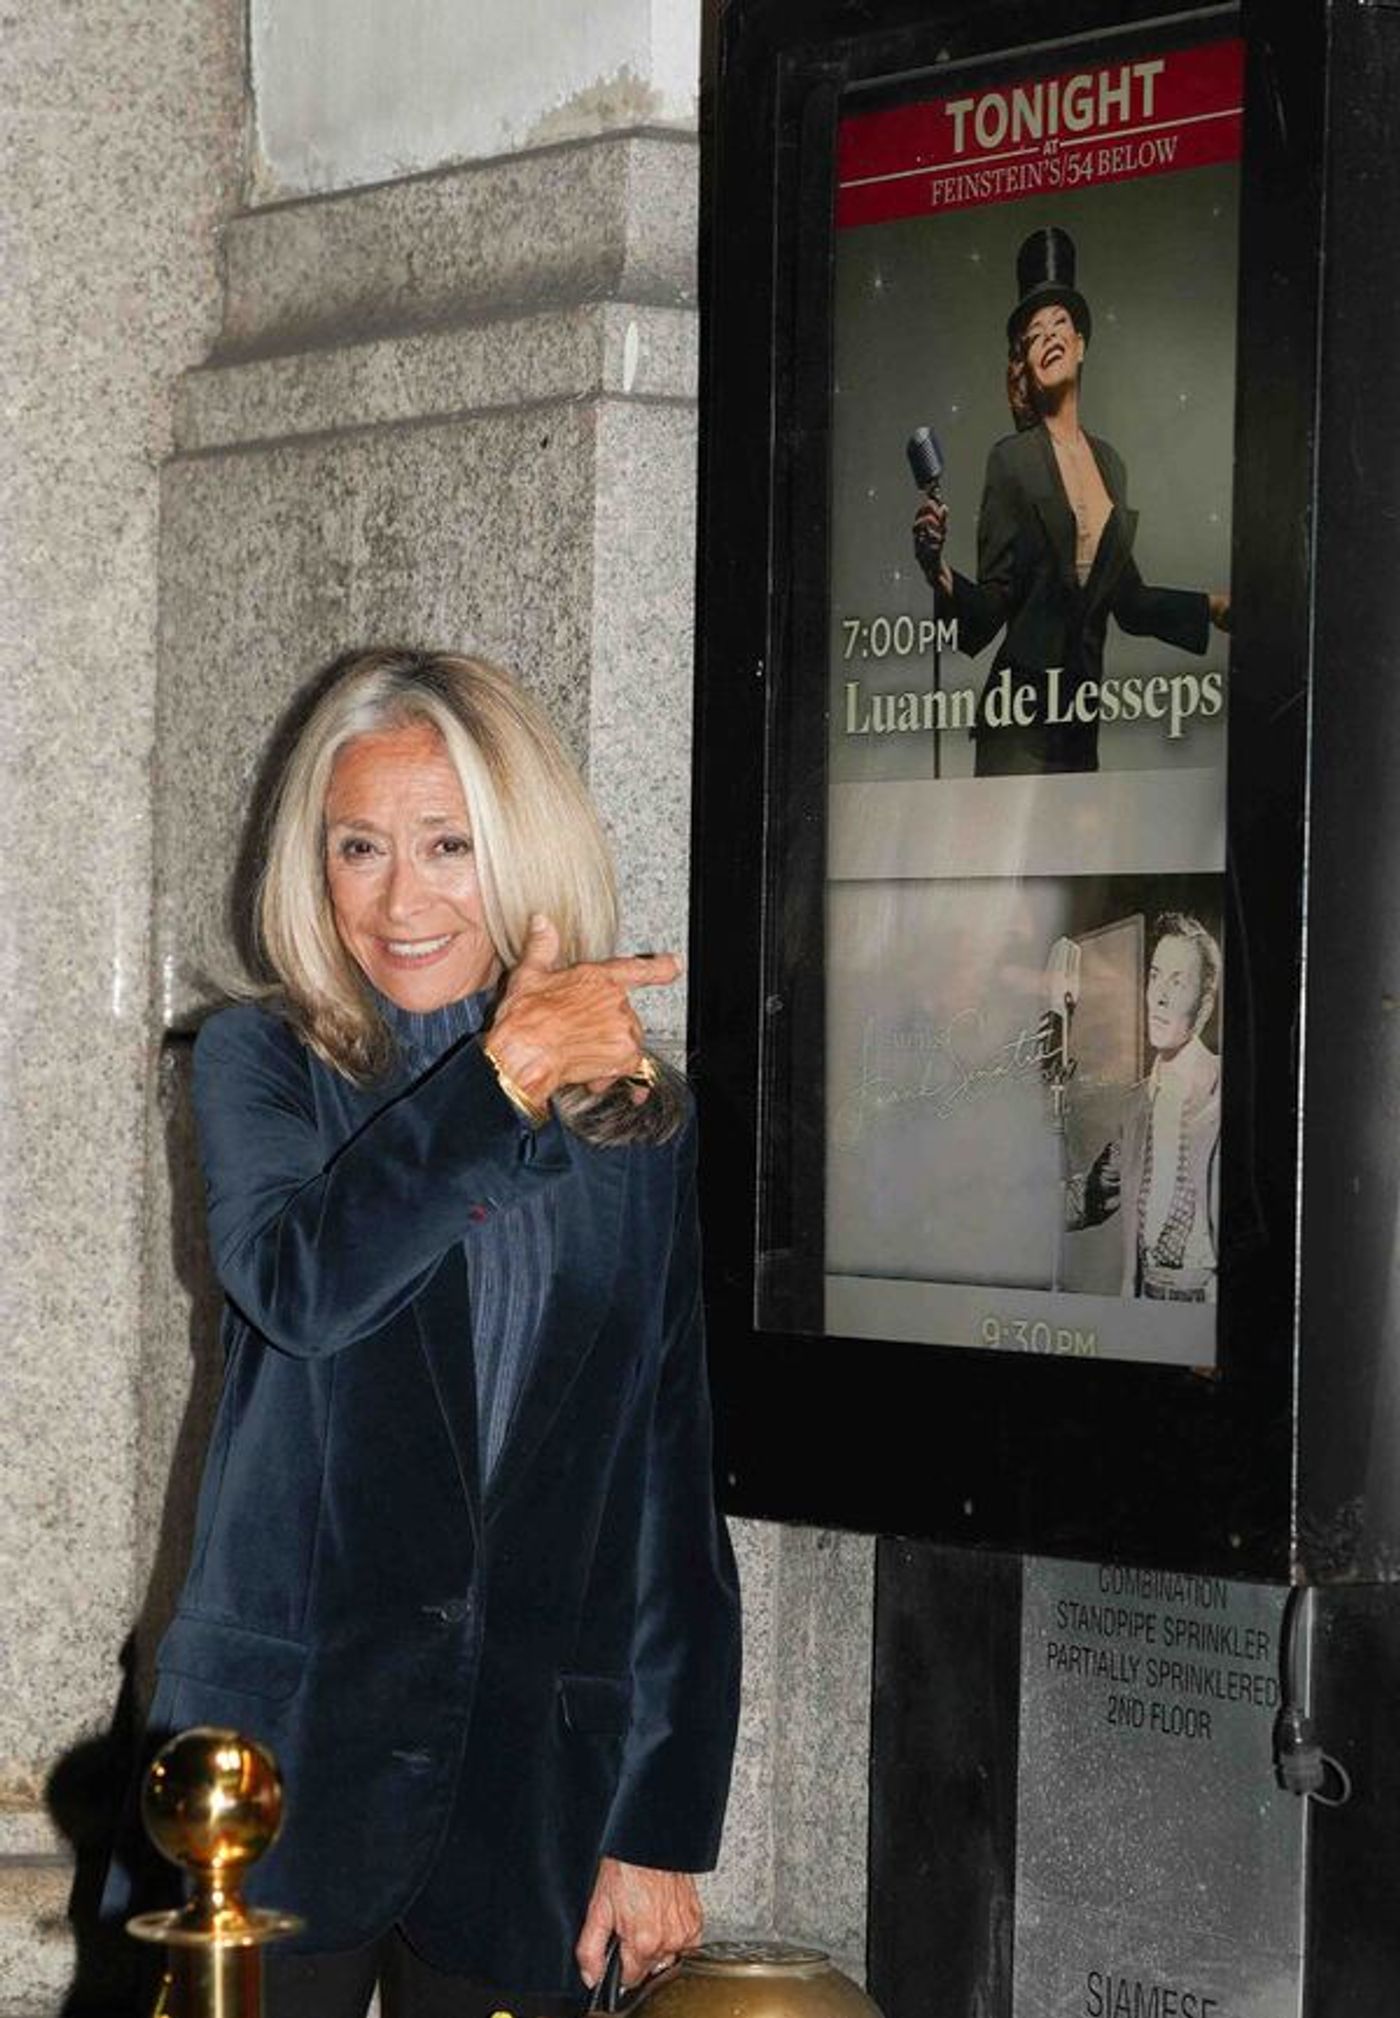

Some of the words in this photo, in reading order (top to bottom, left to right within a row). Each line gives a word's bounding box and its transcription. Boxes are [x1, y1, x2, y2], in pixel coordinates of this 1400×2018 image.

[944, 59, 1165, 153] TONIGHT
[1042, 138, 1060, 156] AT
[1098, 136, 1179, 177] BELOW
[845, 681, 977, 734] Luann
[983, 669, 1037, 729] de
[1044, 667, 1223, 738] Lesseps
[1100, 1566, 1227, 1610] COMBINATION
[1056, 1600, 1158, 1644] STANDPIPE
[1162, 1615, 1271, 1661] SPRINKLER
[1047, 1642, 1142, 1684] PARTIALLY
[1145, 1658, 1280, 1708] SPRINKLERED
[1107, 1695, 1145, 1728] 2ND
[1150, 1702, 1213, 1740] FLOOR
